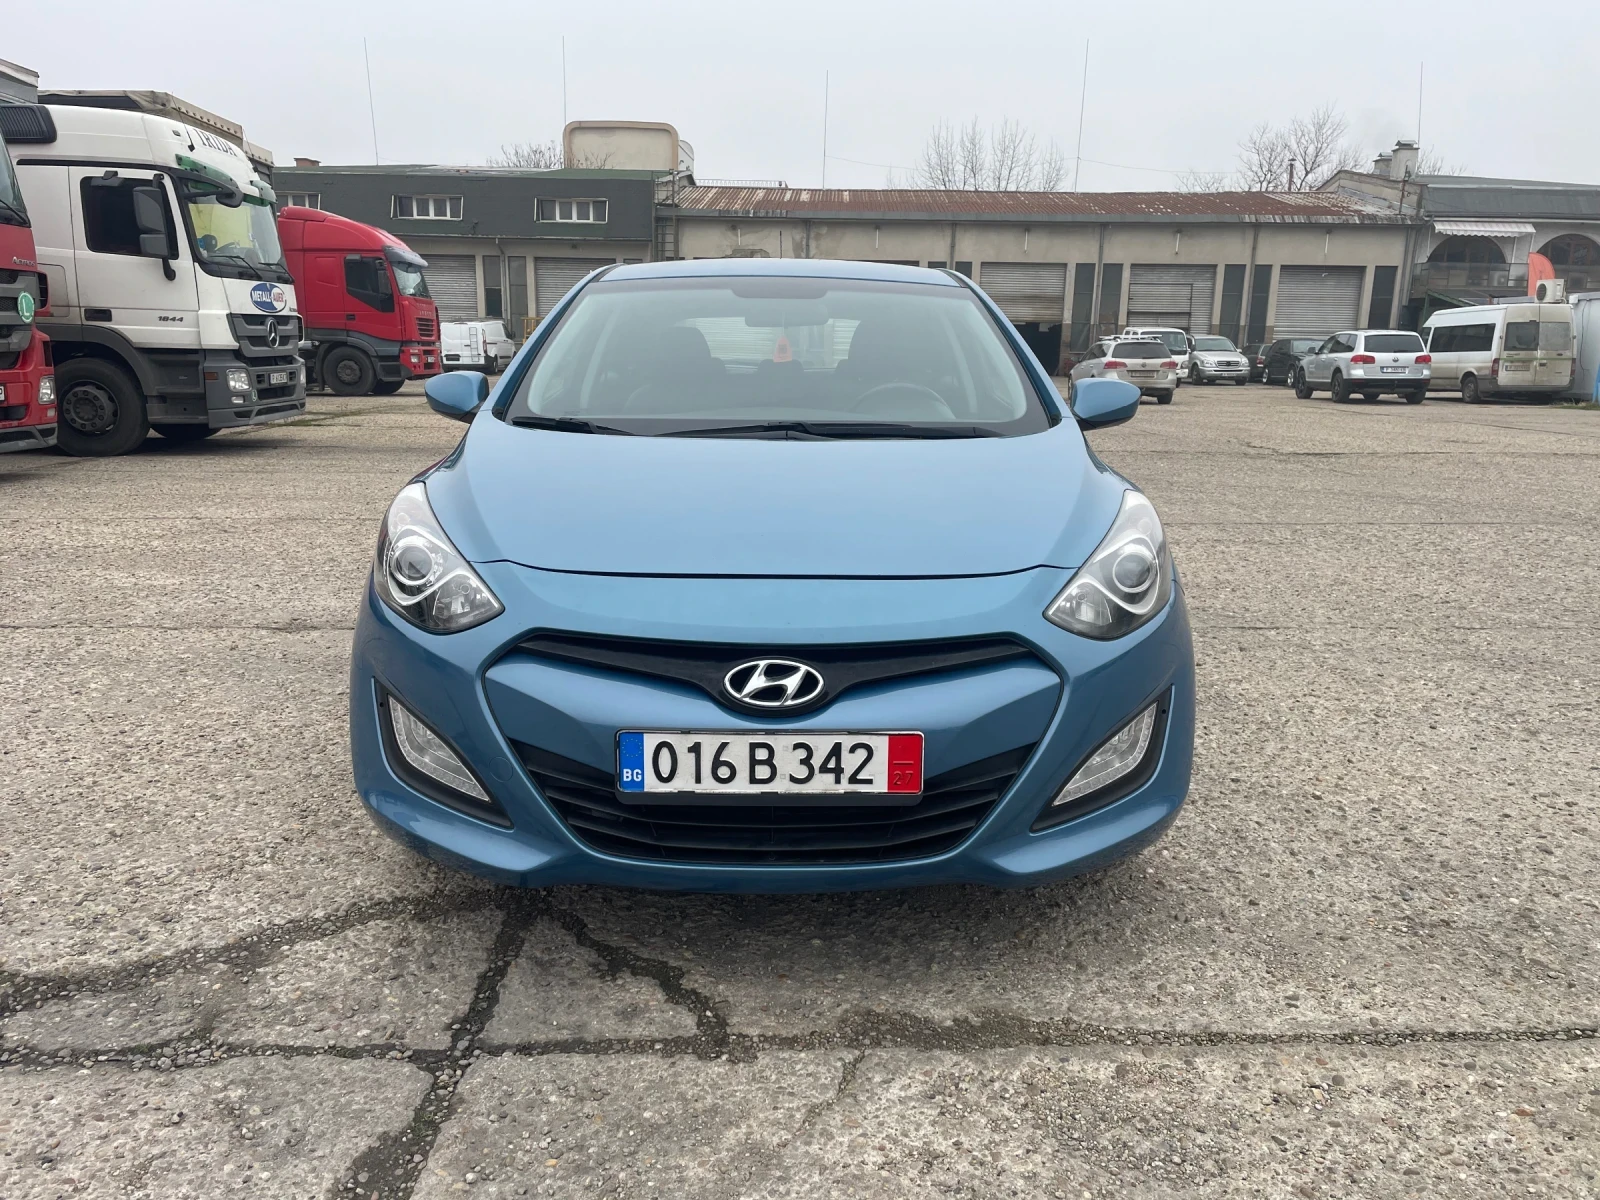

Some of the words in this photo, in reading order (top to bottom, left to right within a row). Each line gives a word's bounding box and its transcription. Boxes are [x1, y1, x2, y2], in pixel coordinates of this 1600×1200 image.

[193, 128, 238, 157] IRIDA
[22, 298, 30, 316] L
[157, 315, 184, 323] 1844
[623, 769, 642, 782] BG
[893, 770, 914, 786] 27
